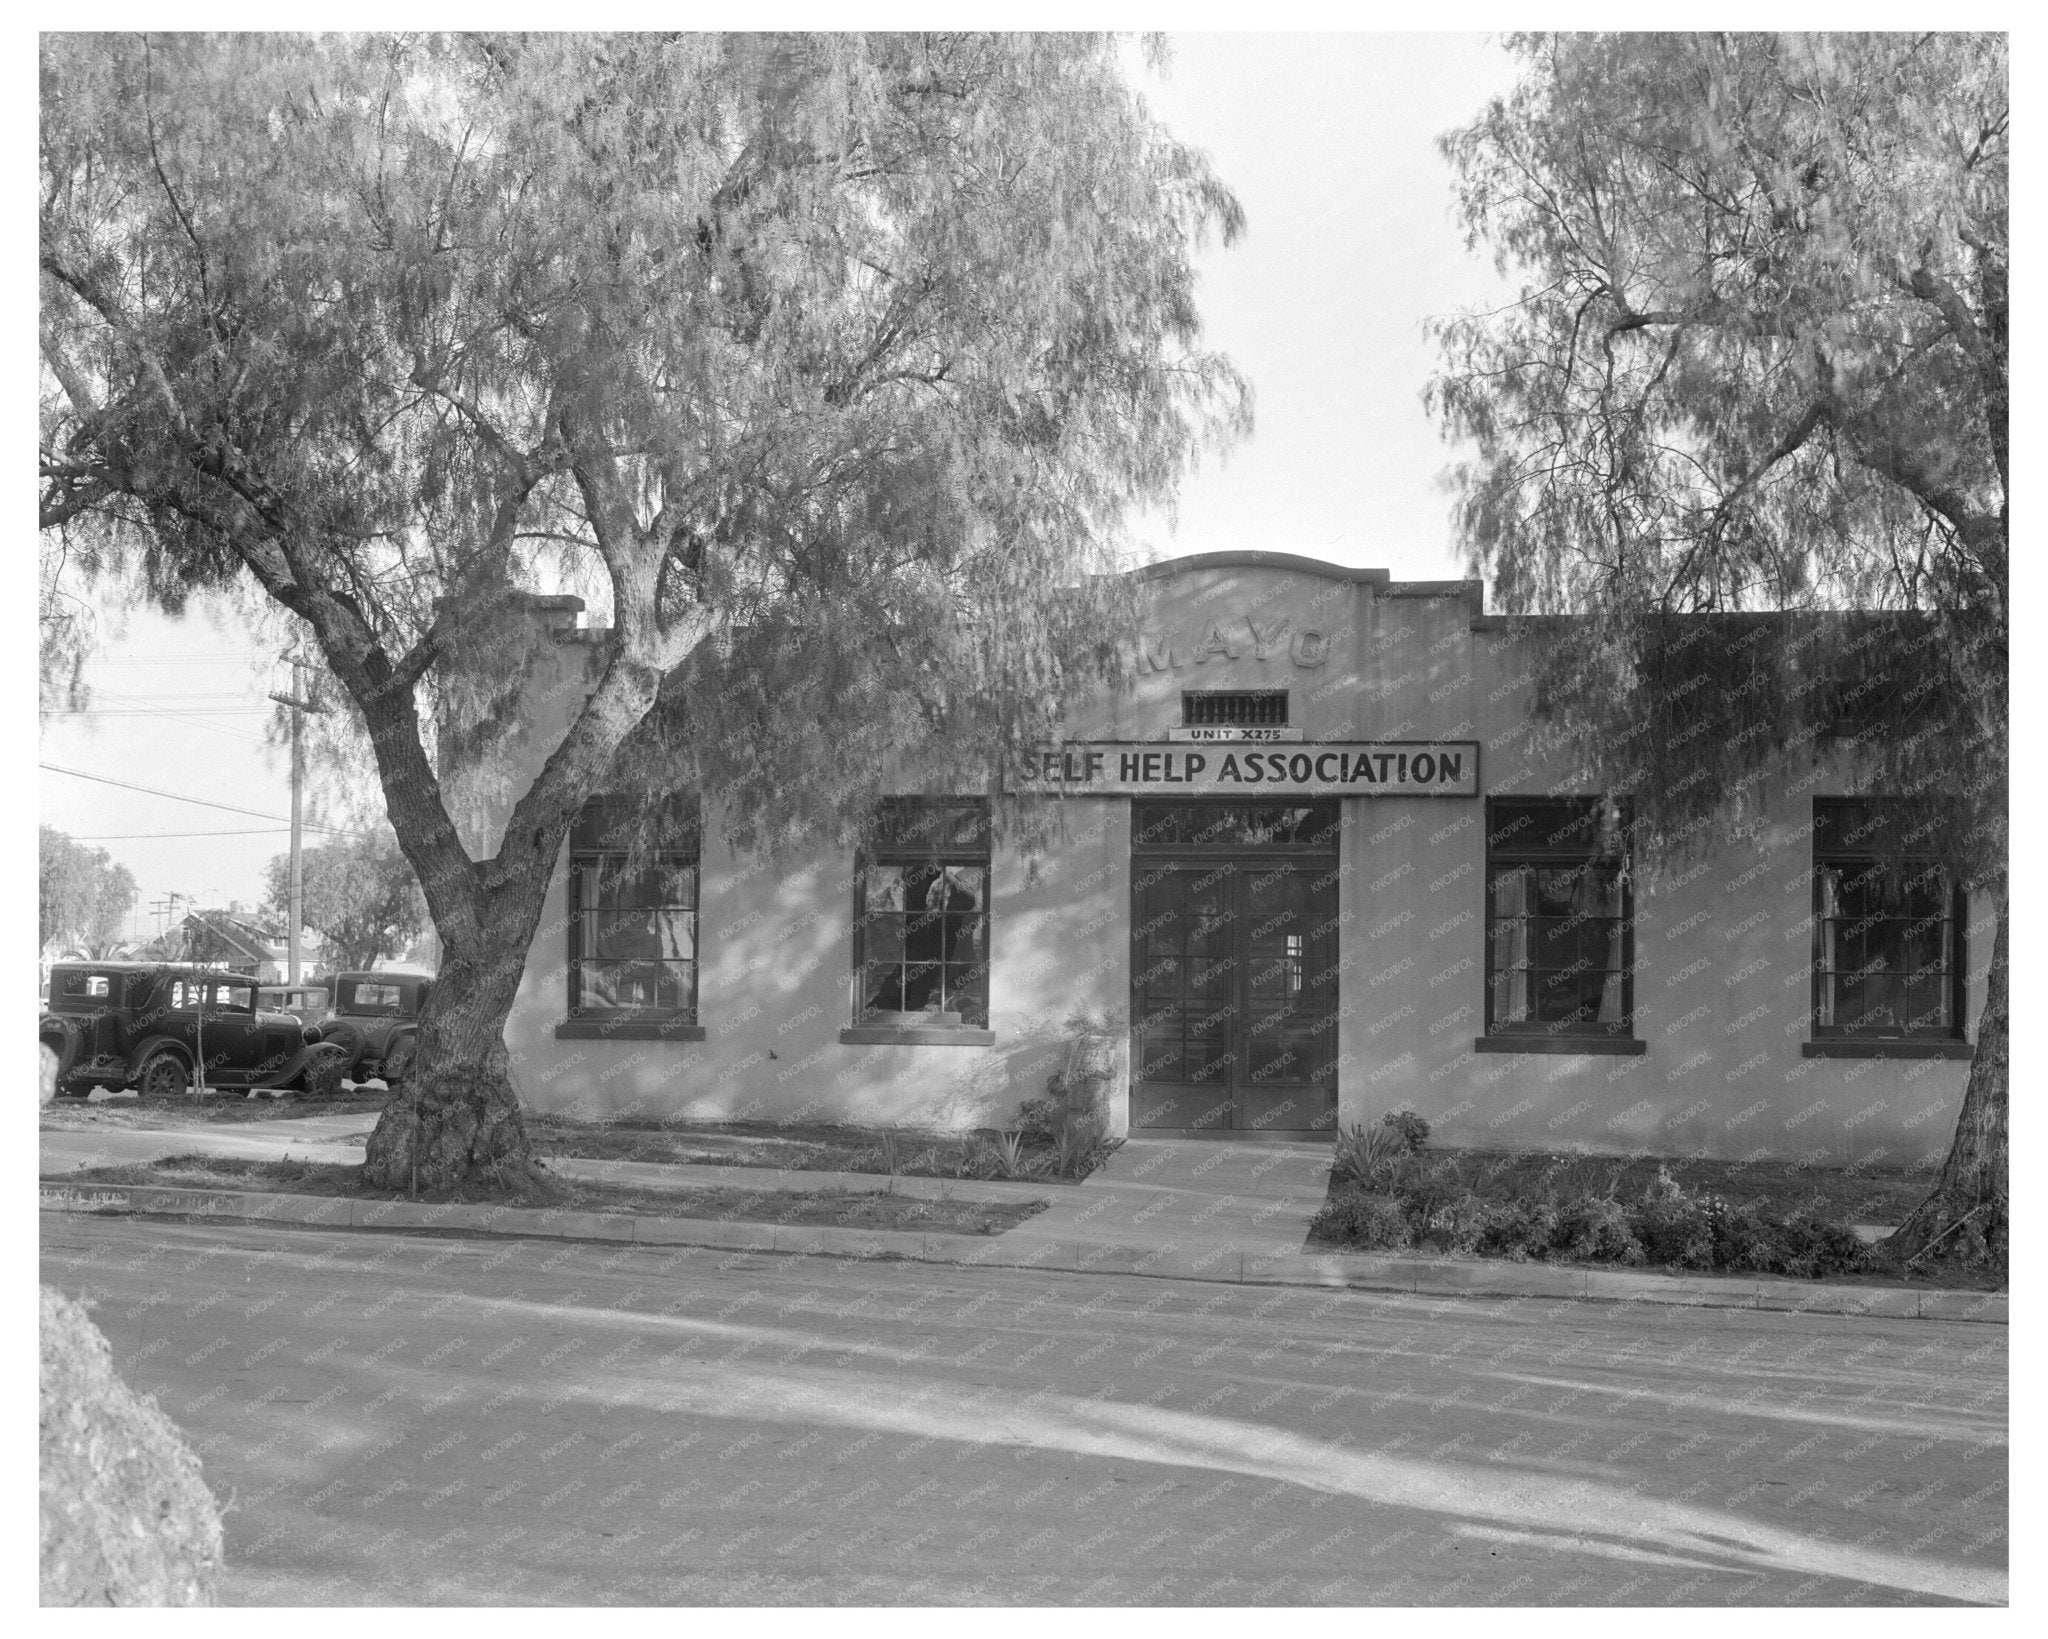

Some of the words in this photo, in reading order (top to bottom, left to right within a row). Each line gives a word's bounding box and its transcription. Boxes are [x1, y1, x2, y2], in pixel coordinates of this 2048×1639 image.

[1135, 616, 1330, 674] MAYO
[1191, 729, 1232, 740] UNIT
[1241, 729, 1281, 740] X275
[1020, 752, 1104, 782] SELF
[1120, 753, 1206, 782] HELP
[1217, 752, 1462, 784] ASSOCIATION
